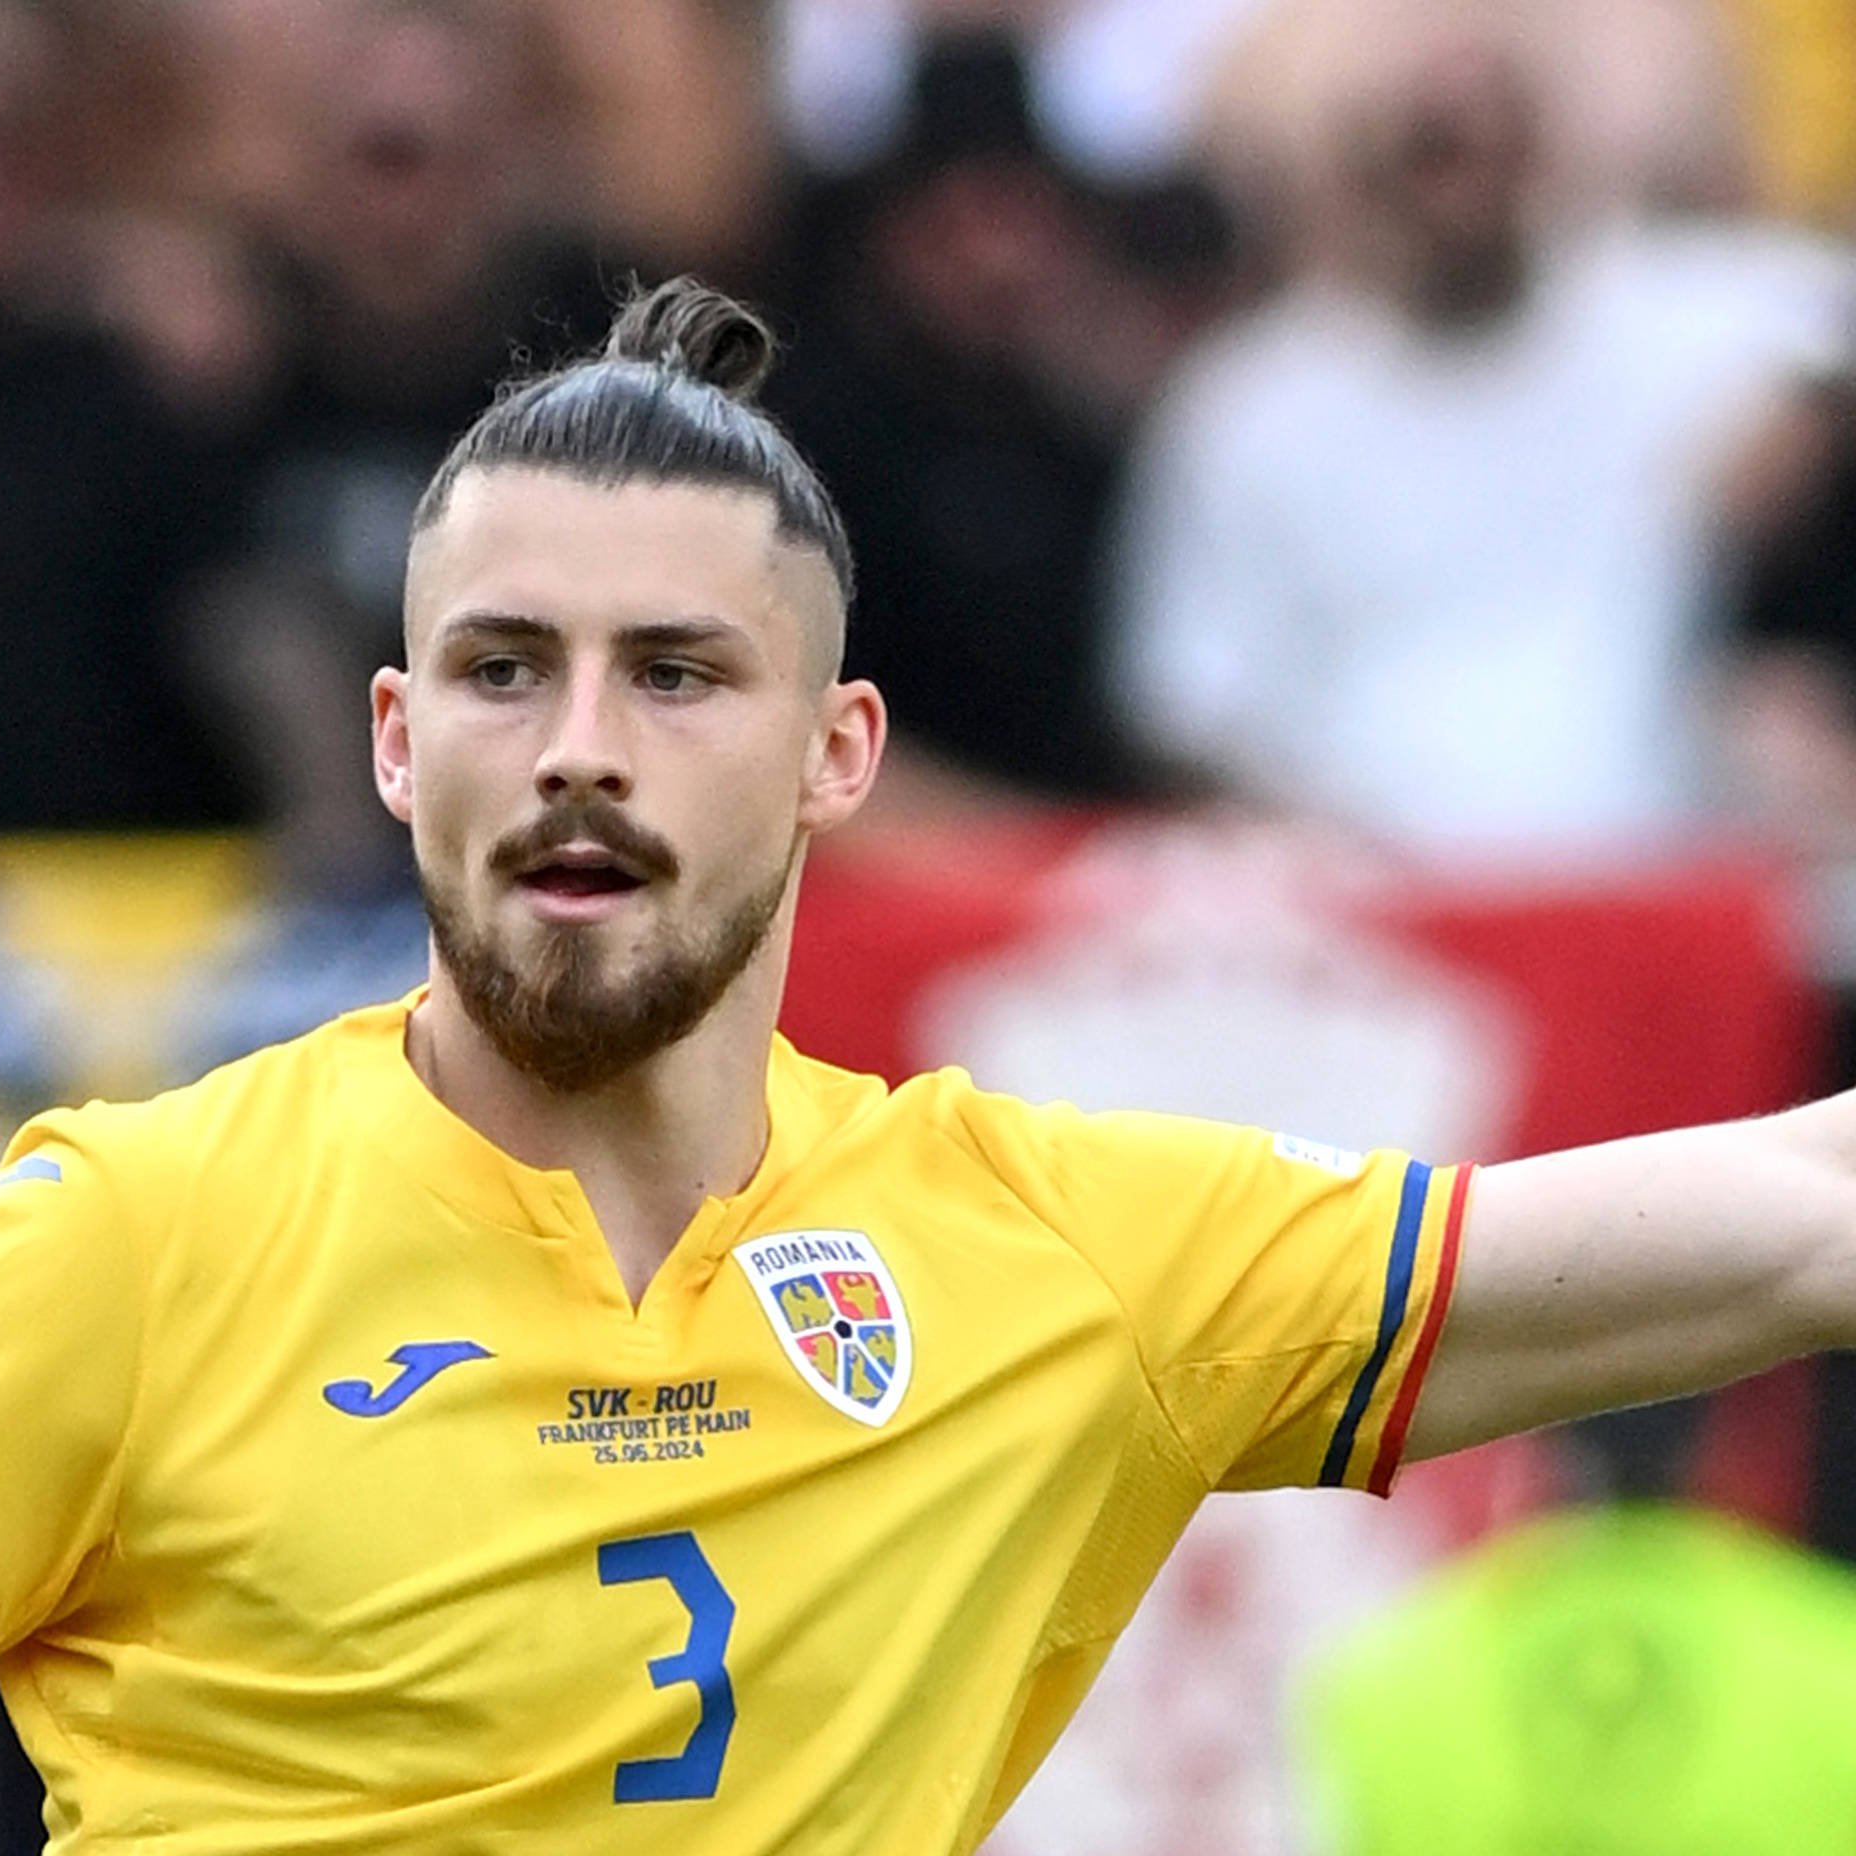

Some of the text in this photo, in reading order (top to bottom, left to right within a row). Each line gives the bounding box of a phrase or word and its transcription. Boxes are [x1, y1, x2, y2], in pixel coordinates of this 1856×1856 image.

[750, 1235, 866, 1277] ROMÂNIA
[567, 1386, 632, 1420] SVK
[653, 1378, 717, 1414] ROU
[537, 1408, 751, 1445] FRANKFURT PE MAIN
[591, 1440, 705, 1465] 25.06.2024
[597, 1530, 736, 1804] 3
